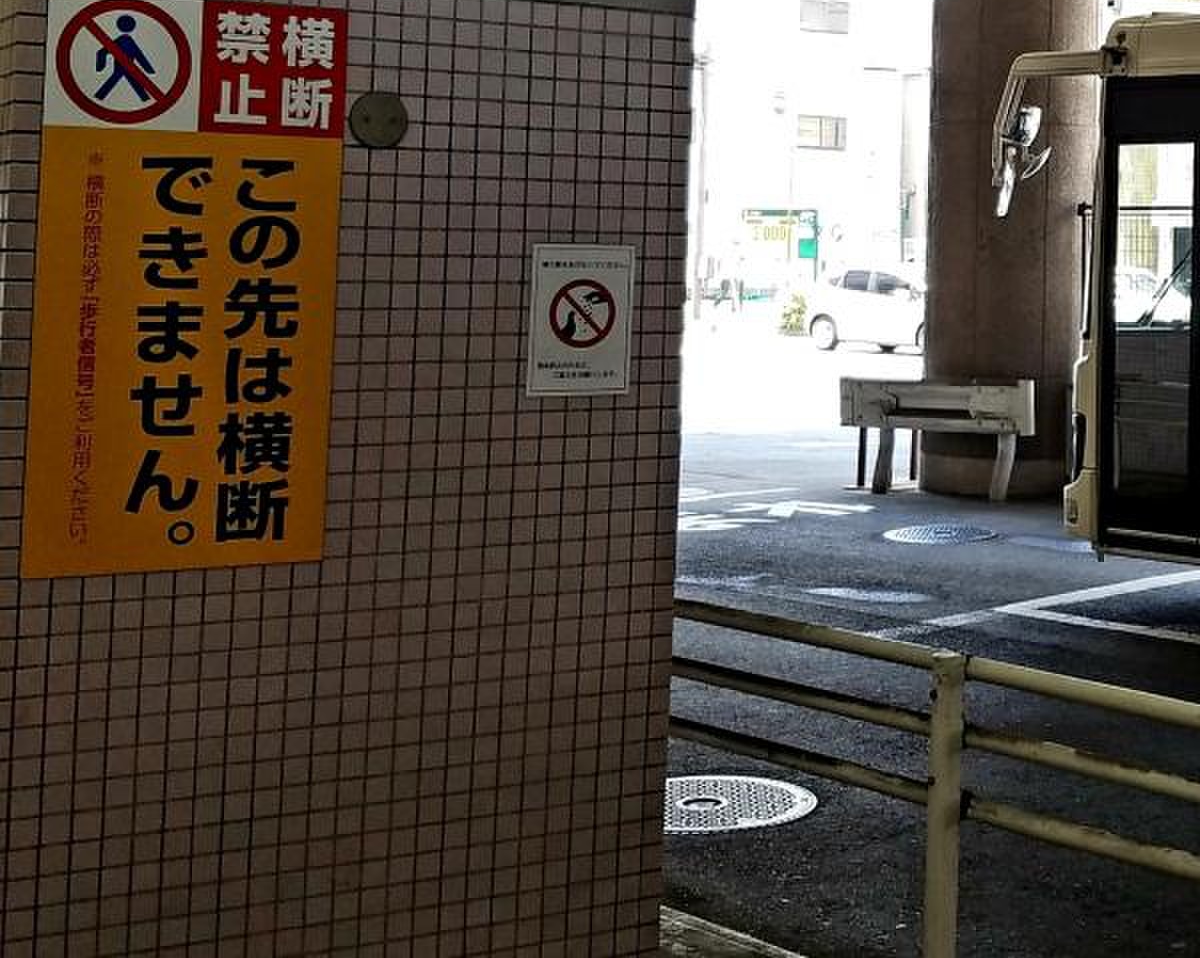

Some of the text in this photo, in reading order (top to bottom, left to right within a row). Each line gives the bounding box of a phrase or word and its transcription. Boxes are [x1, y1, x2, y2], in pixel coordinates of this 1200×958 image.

[213, 10, 272, 126] 禁止
[281, 14, 335, 131] 横断
[125, 155, 214, 547] できません。
[215, 157, 299, 545] この先は横断
